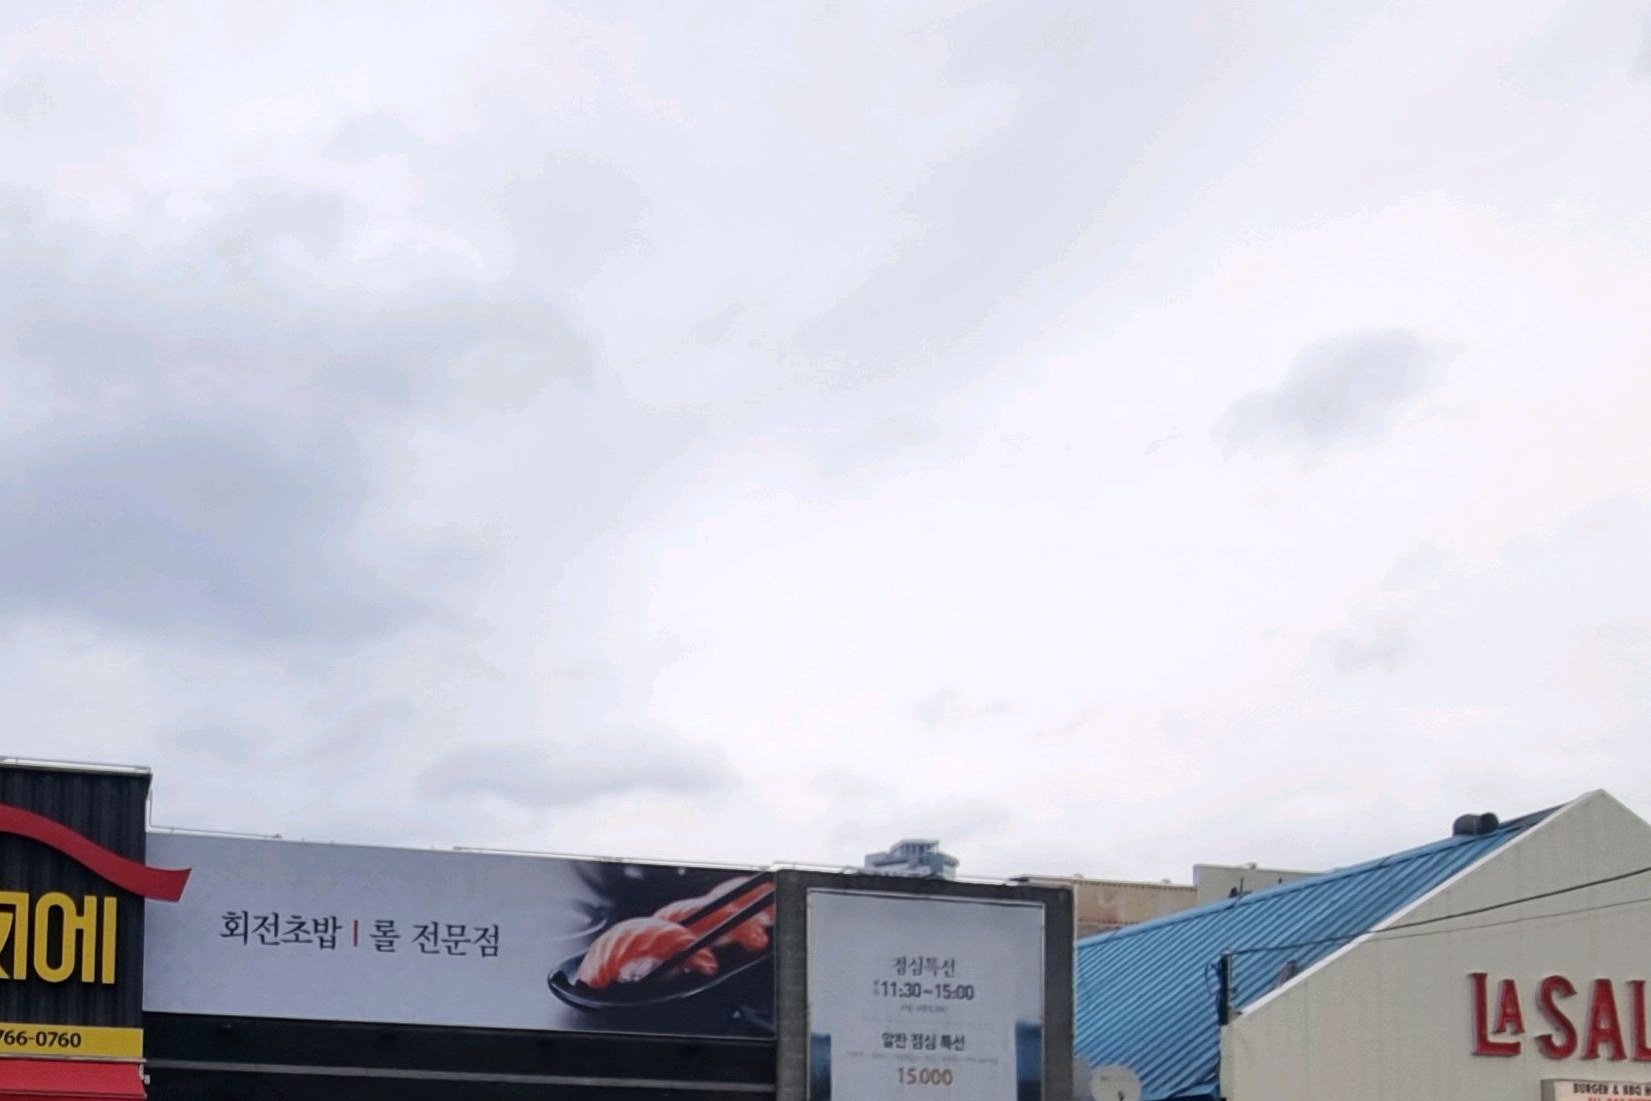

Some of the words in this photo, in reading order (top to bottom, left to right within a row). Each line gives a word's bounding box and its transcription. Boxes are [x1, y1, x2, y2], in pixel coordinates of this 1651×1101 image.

[219, 910, 343, 951] 회전초밥
[370, 919, 401, 954] 롤
[411, 921, 501, 957] 전문점
[892, 956, 956, 978] 점심특선
[1466, 972, 1526, 1057] LA
